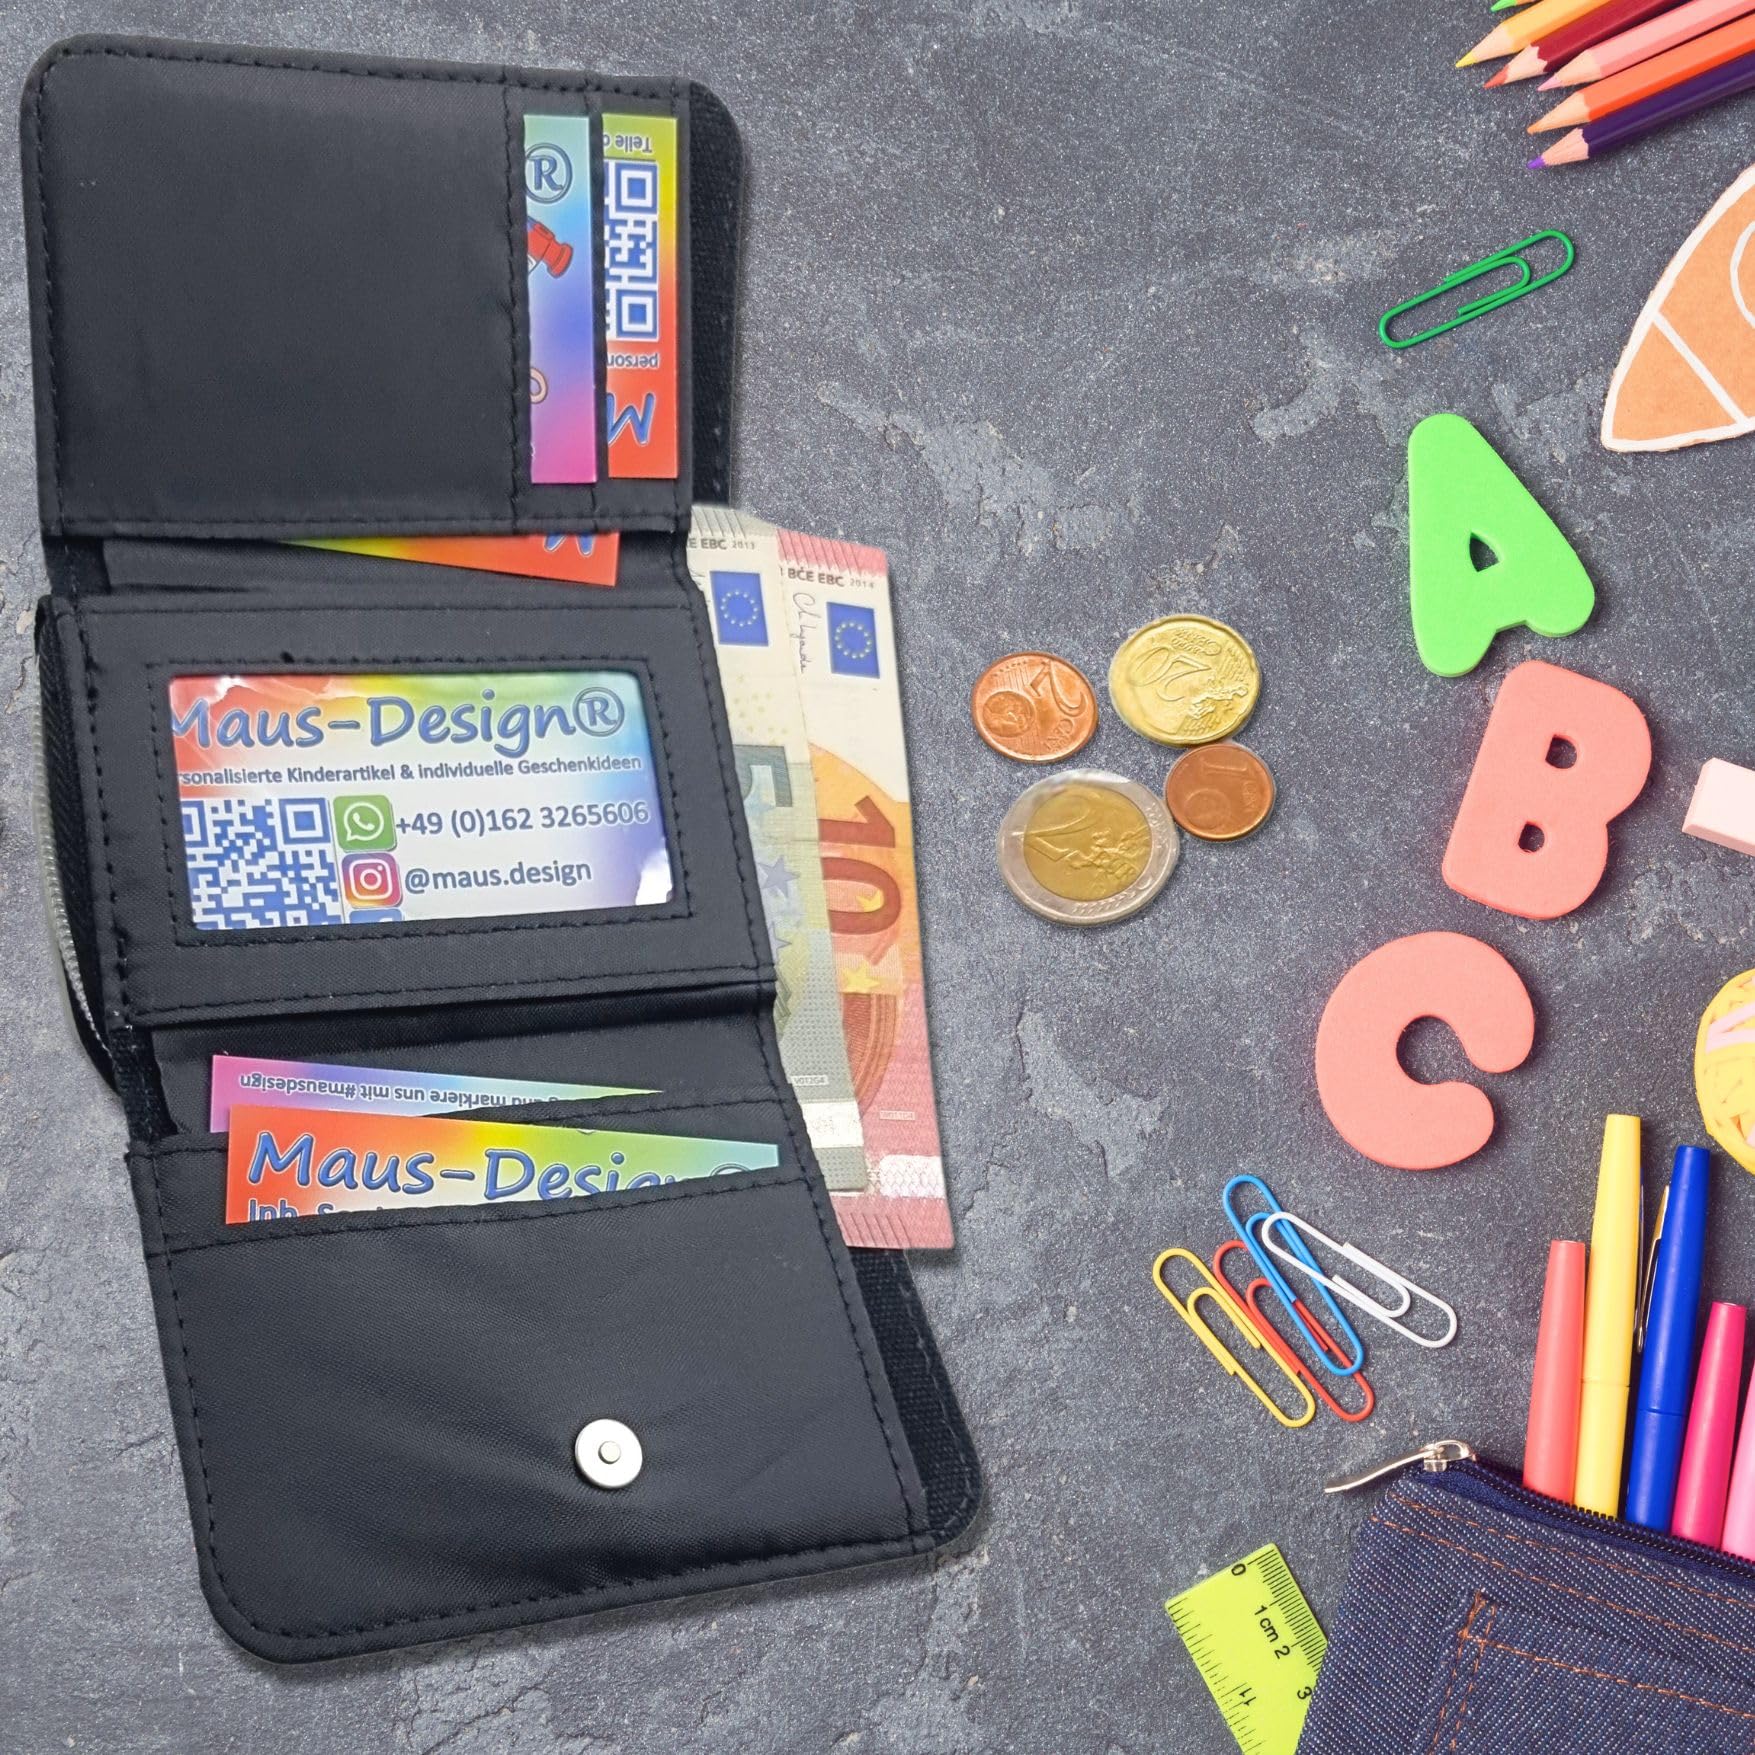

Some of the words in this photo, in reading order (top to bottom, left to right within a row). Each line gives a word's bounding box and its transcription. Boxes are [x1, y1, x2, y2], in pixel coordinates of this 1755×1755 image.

[701, 538, 727, 550] EBC
[1408, 413, 1595, 678] A
[818, 573, 844, 587] EBC
[287, 764, 395, 783] Kinderartikel
[400, 764, 414, 780] &
[419, 760, 513, 779] individuelle
[518, 756, 641, 774] Geschenkideen
[1442, 659, 1651, 920] B
[396, 812, 443, 835] +49
[451, 808, 533, 838] (0)162
[540, 801, 649, 829] 3265606
[405, 860, 592, 894] @maus.design
[1316, 931, 1535, 1170] C
[240, 1073, 357, 1098] #mausdesign
[361, 1085, 389, 1100] mit
[394, 1088, 424, 1100] uns
[1231, 1563, 1247, 1577] 0
[1254, 1605, 1268, 1616] 1
[1259, 1617, 1280, 1643] cm
[1274, 1645, 1290, 1659] 2
[1297, 1686, 1312, 1700] 3
